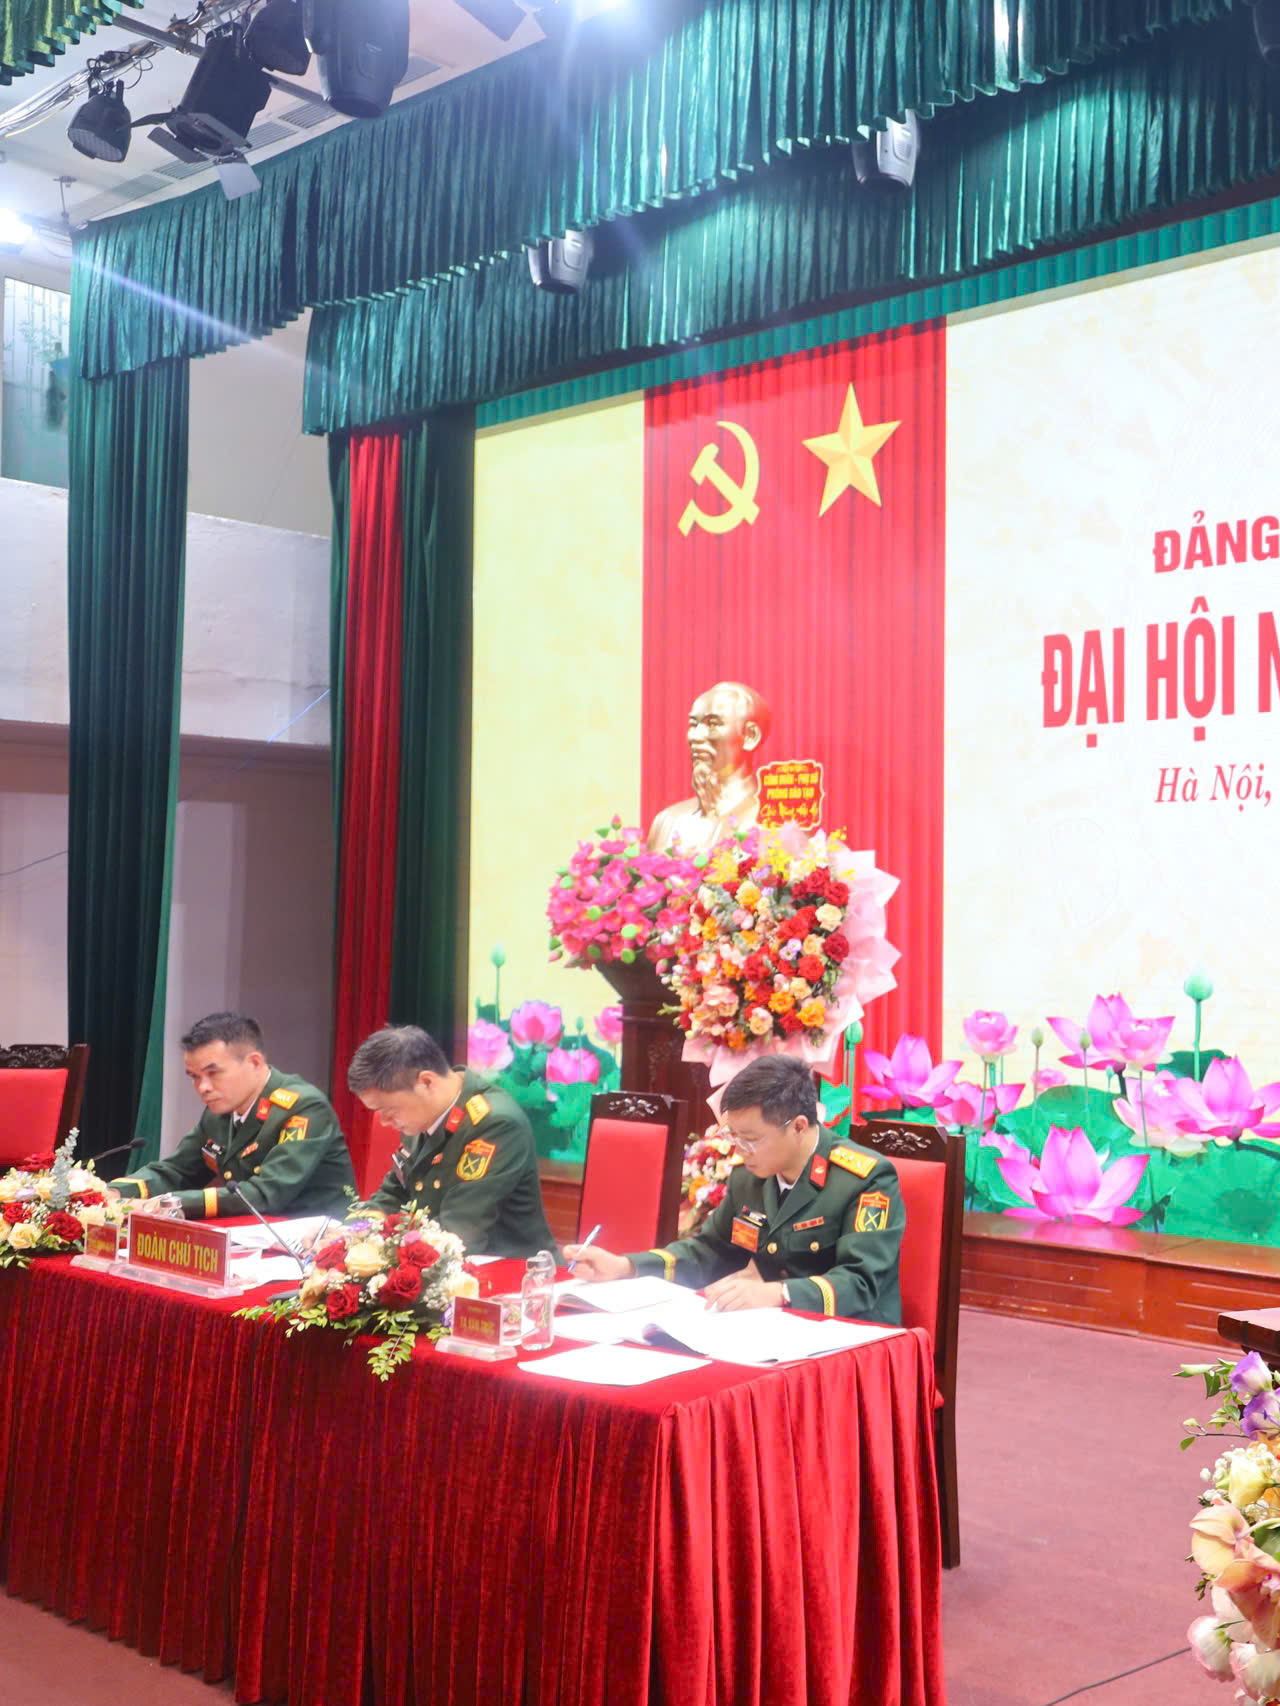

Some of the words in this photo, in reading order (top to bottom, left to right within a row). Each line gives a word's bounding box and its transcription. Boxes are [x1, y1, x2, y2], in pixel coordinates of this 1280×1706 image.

[1152, 510, 1280, 574] ĐẢNG
[1041, 627, 1126, 748] ĐẠI
[1146, 595, 1236, 742] HỘI
[1155, 764, 1198, 804] Hà
[1209, 760, 1272, 811] Nội,
[136, 1231, 167, 1262] ĐOÀN
[168, 1234, 191, 1266] CHỦ
[194, 1245, 219, 1275] TỊCH
